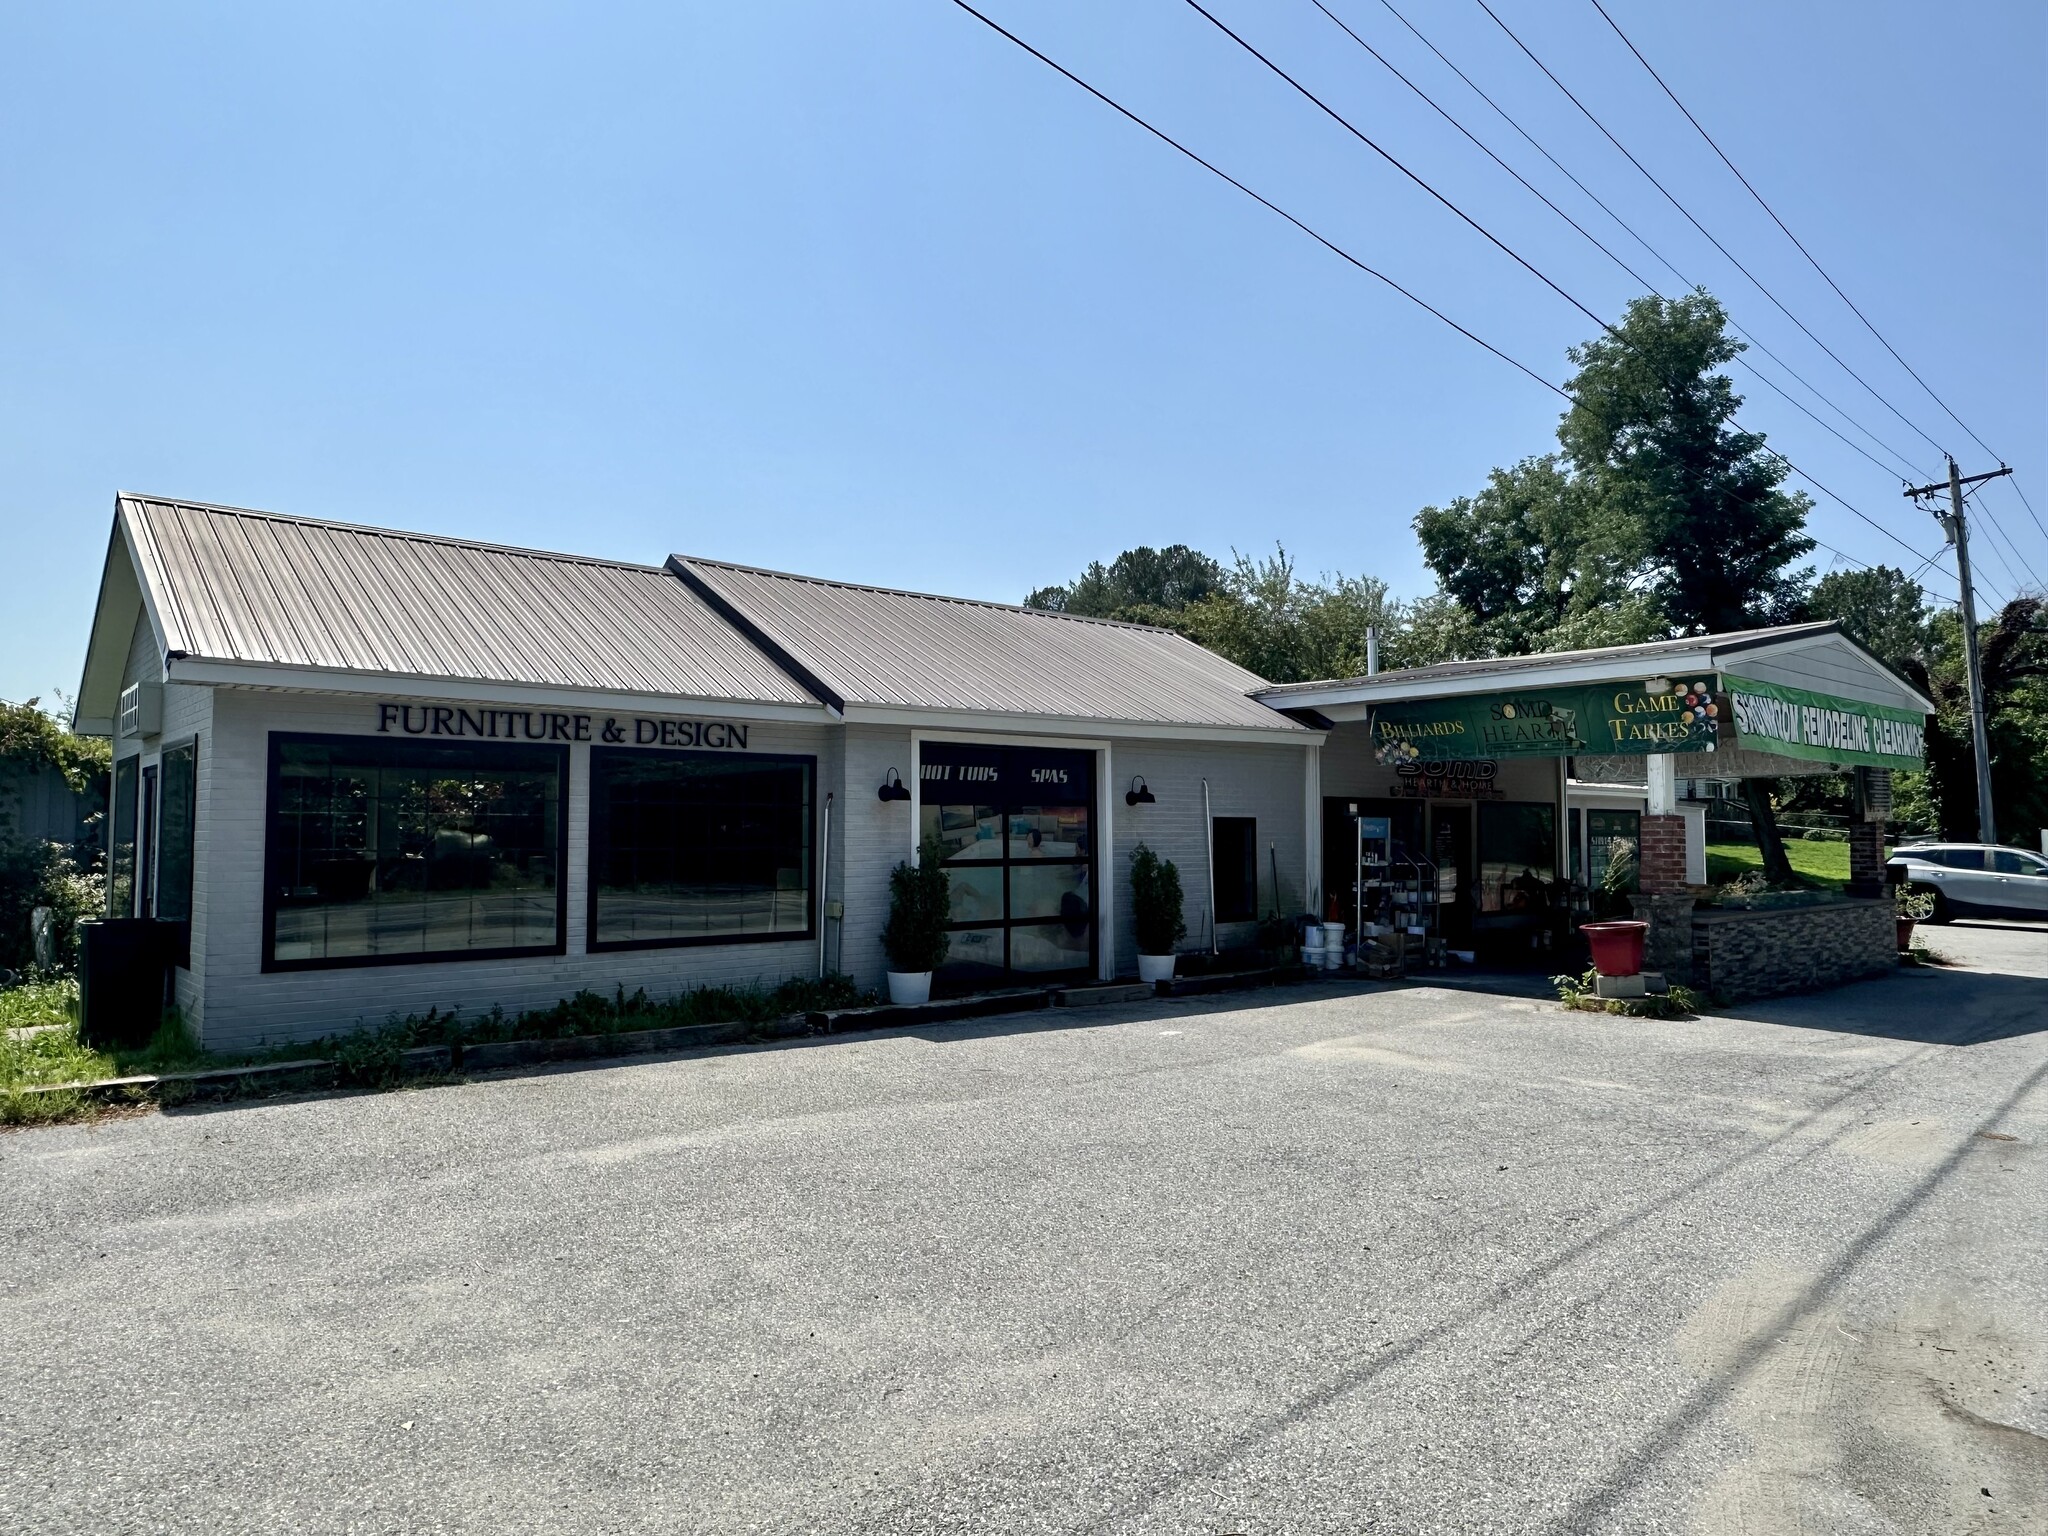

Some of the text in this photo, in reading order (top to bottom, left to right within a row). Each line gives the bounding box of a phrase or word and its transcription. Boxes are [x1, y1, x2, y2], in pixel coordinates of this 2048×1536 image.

[1614, 692, 1680, 714] GAME
[377, 703, 749, 749] FURNITURE & DESIGN
[1378, 720, 1465, 740] BILLIARDS
[1482, 720, 1578, 741] HEARTH
[1609, 719, 1689, 741] TABLES
[1732, 692, 1924, 759] SHOWROOM REMODELING CLEARANCE
[959, 766, 998, 781] TUBS
[1031, 768, 1068, 783] SPAS
[1461, 779, 1493, 791] HOME
